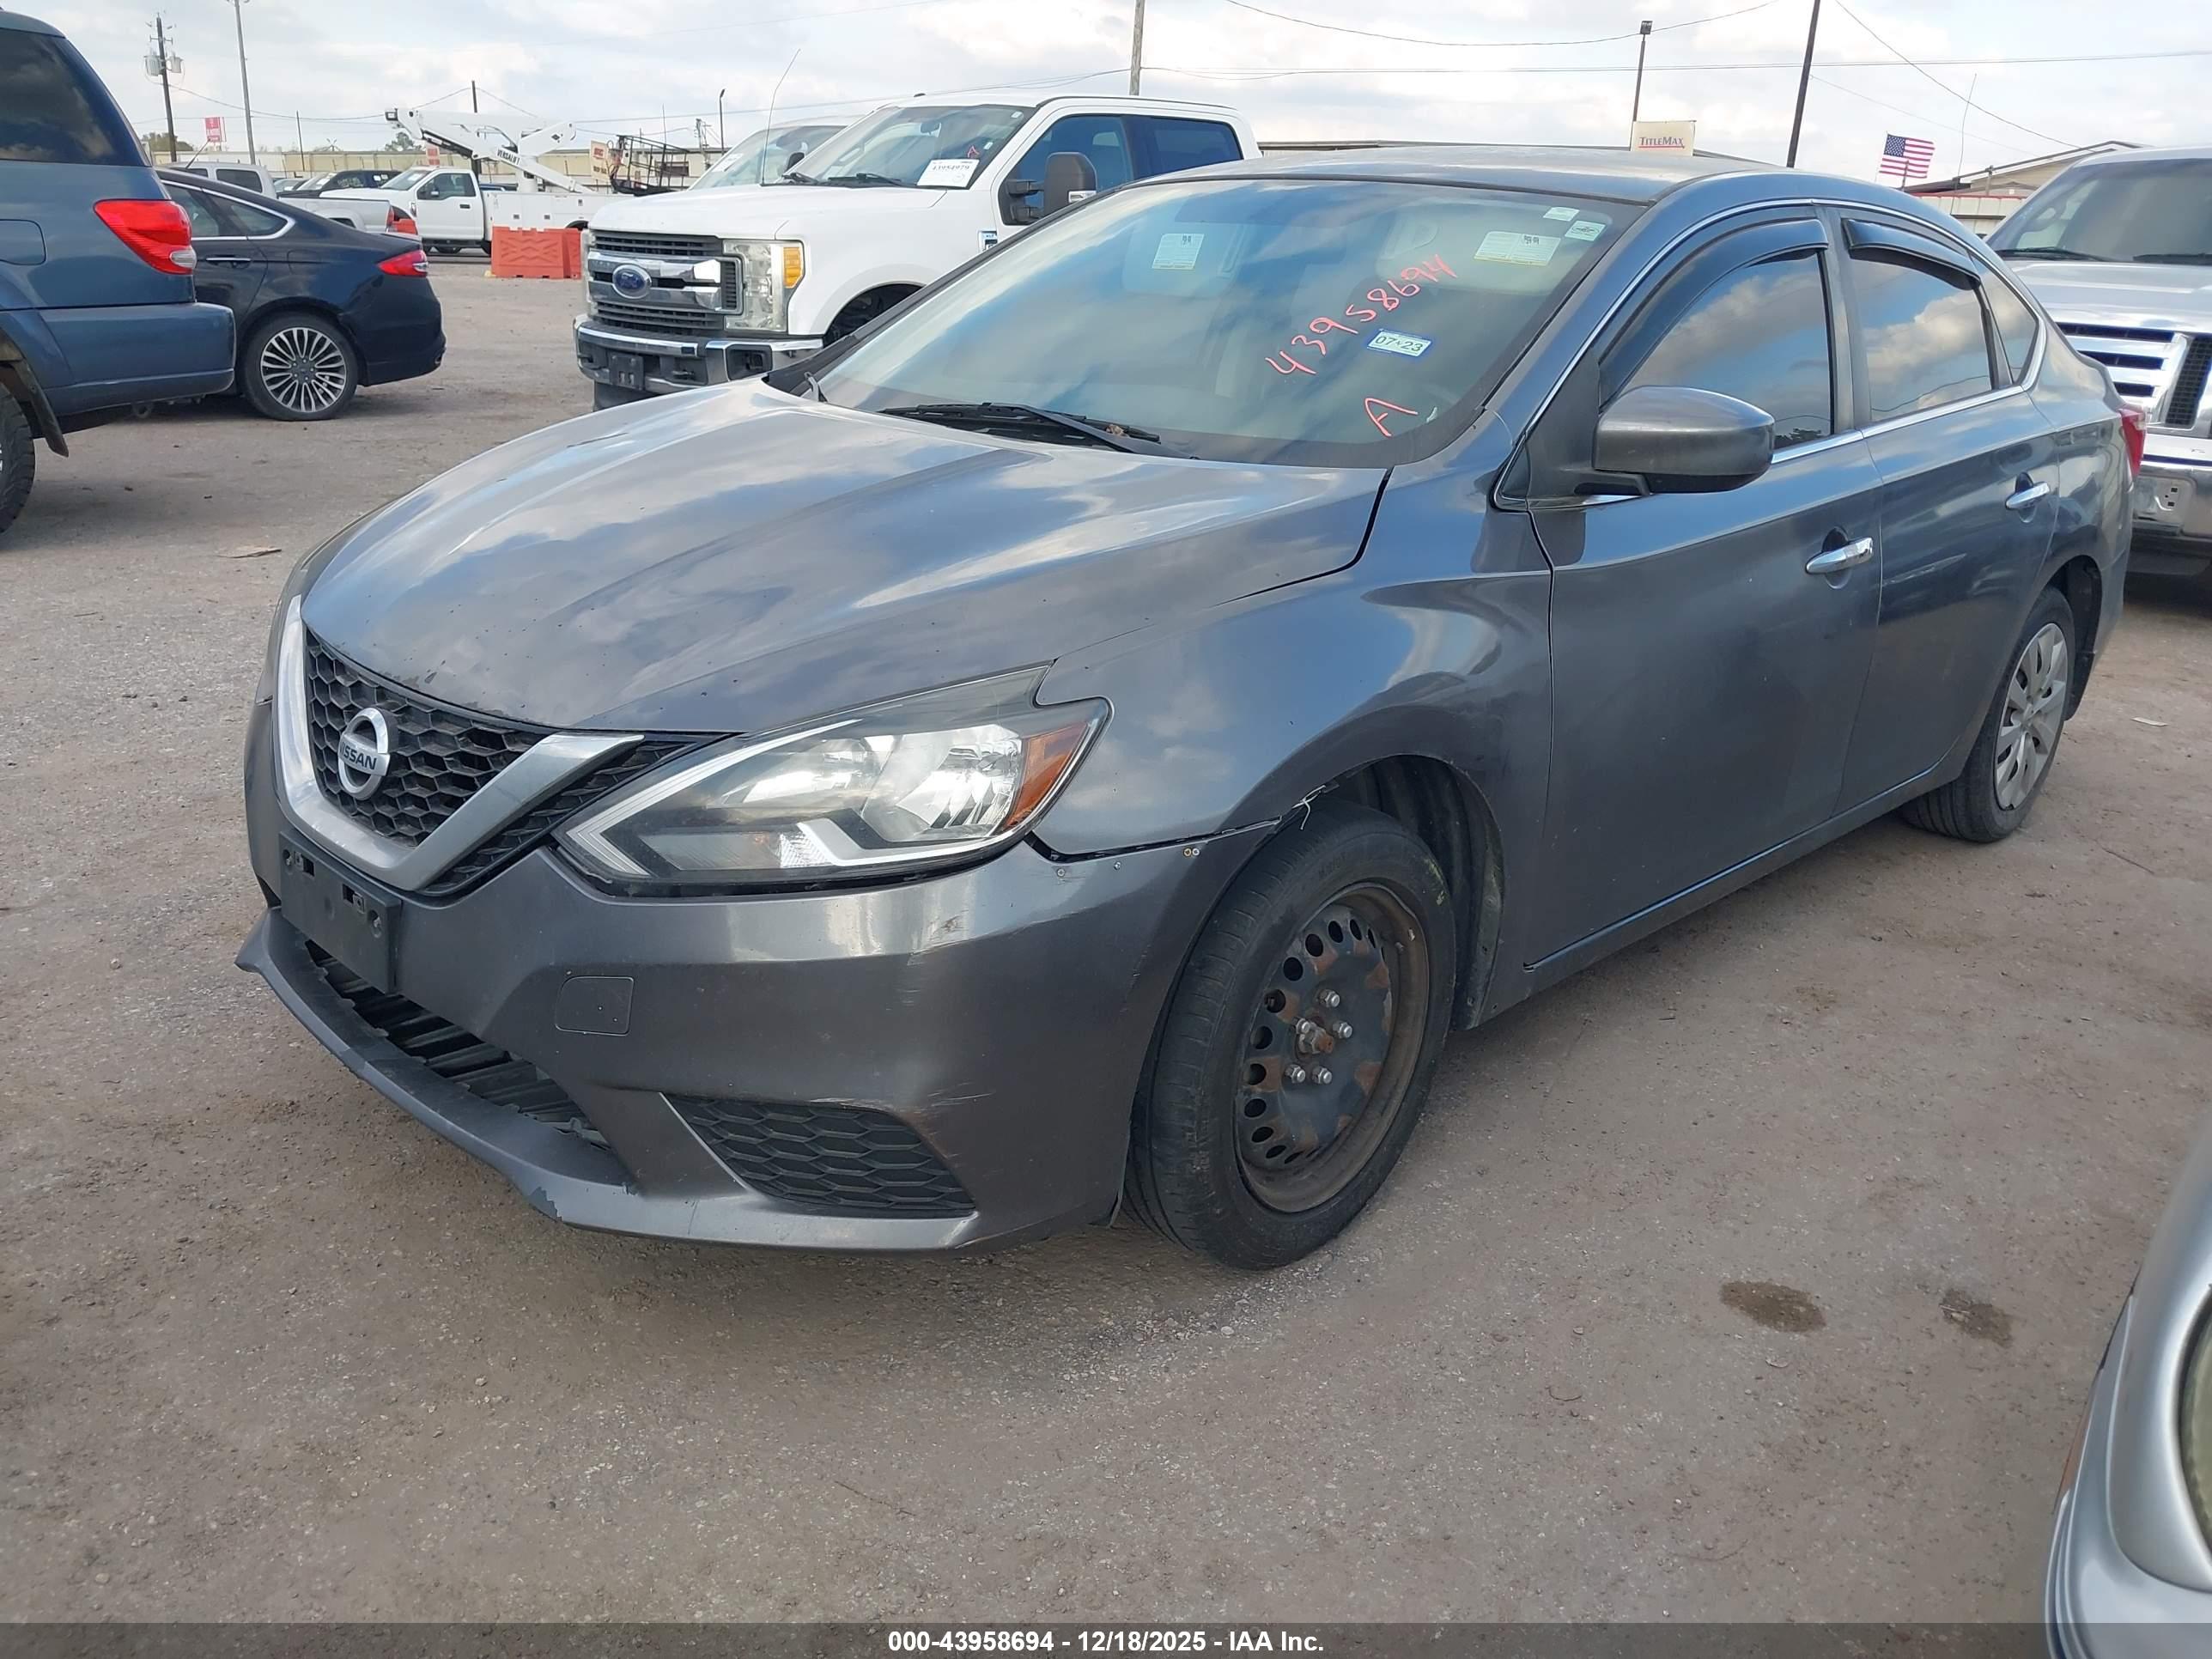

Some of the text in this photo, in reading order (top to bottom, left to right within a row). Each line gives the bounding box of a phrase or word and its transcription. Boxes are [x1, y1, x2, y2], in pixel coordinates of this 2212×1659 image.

[1265, 254, 1457, 374] 43958694
[1364, 398, 1418, 437] A
[340, 741, 377, 770] NISSAN
